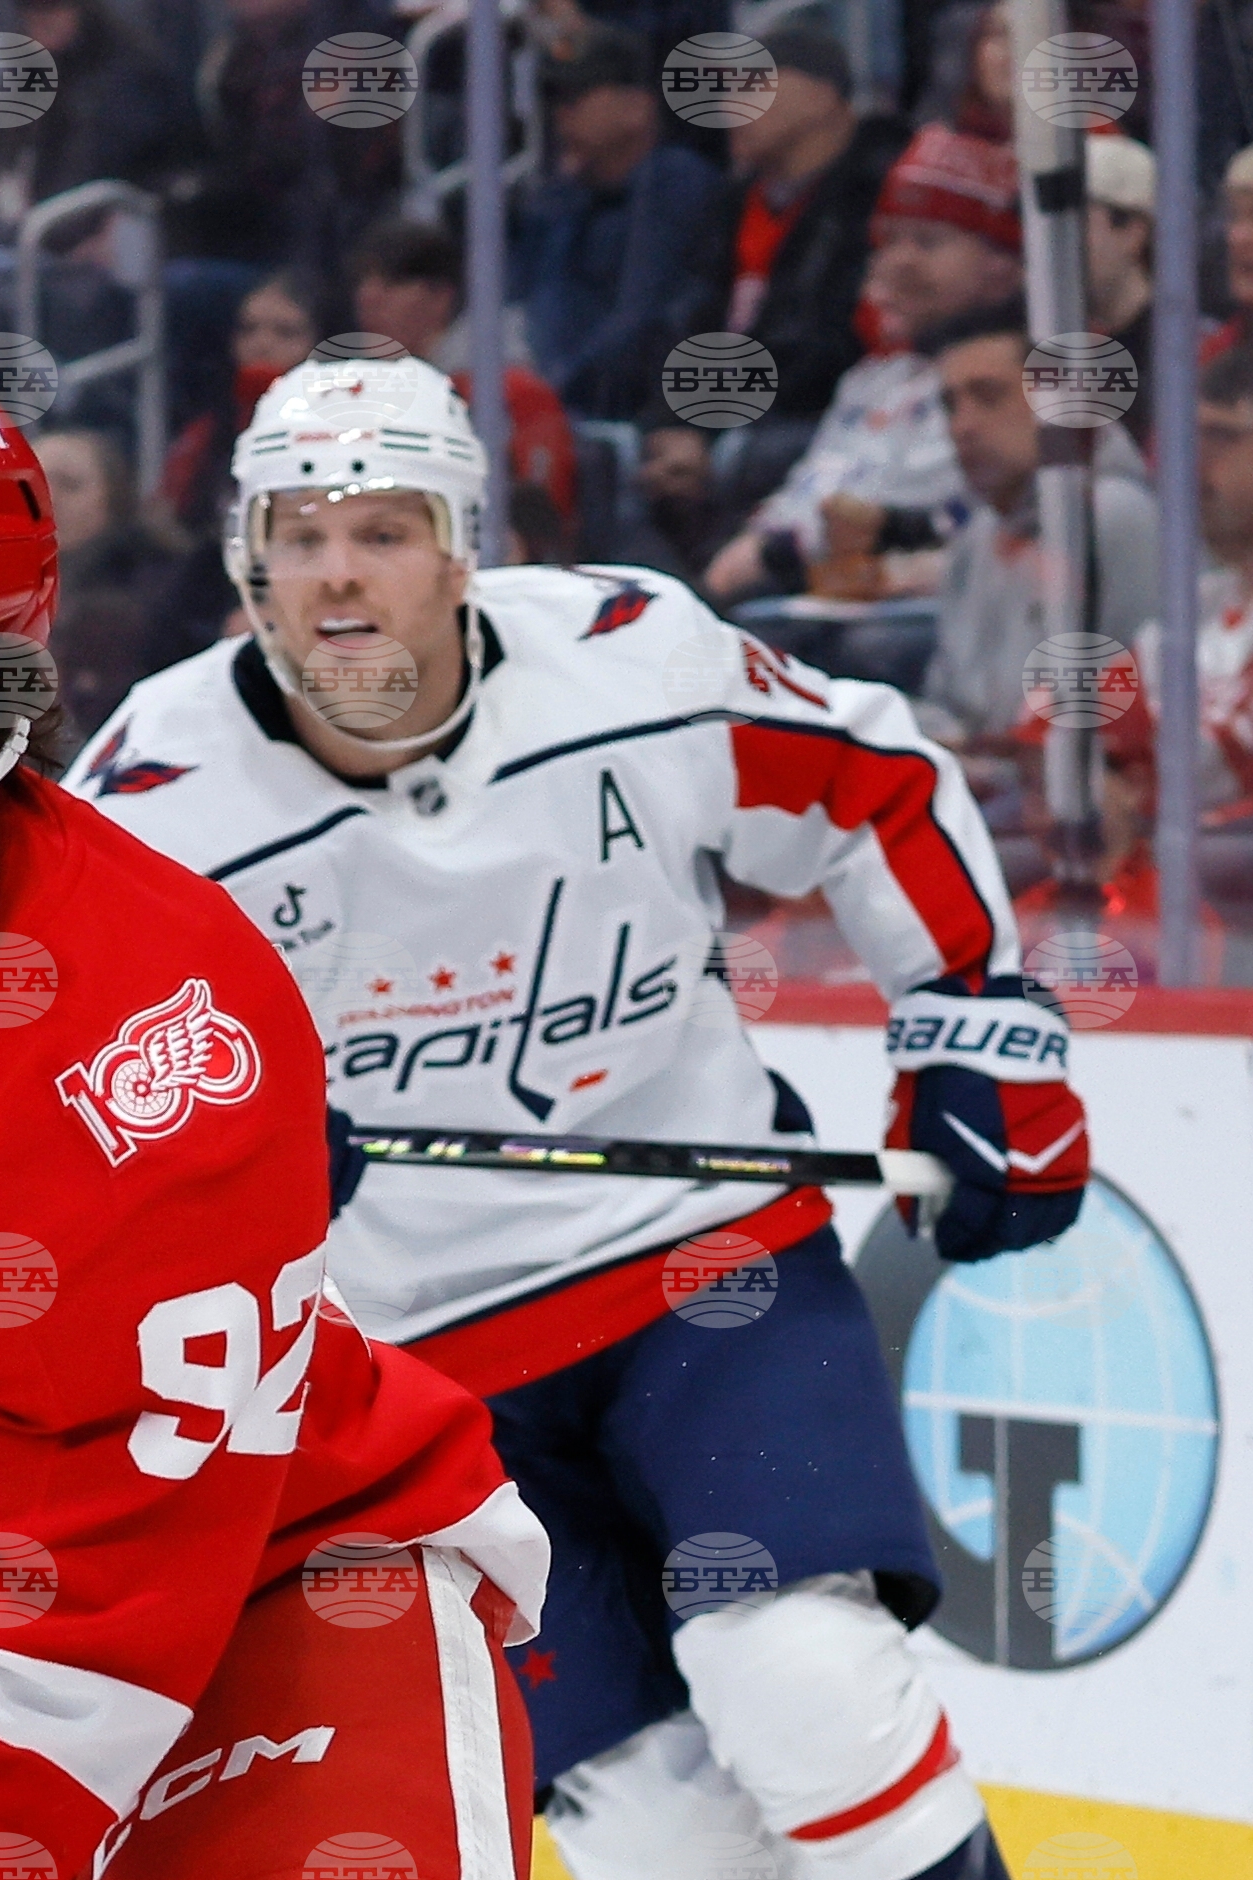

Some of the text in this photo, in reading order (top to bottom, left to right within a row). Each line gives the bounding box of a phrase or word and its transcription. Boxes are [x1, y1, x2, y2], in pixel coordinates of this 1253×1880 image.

[599, 768, 644, 863] A
[324, 877, 678, 1122] apitals
[127, 1242, 327, 1481] 92
